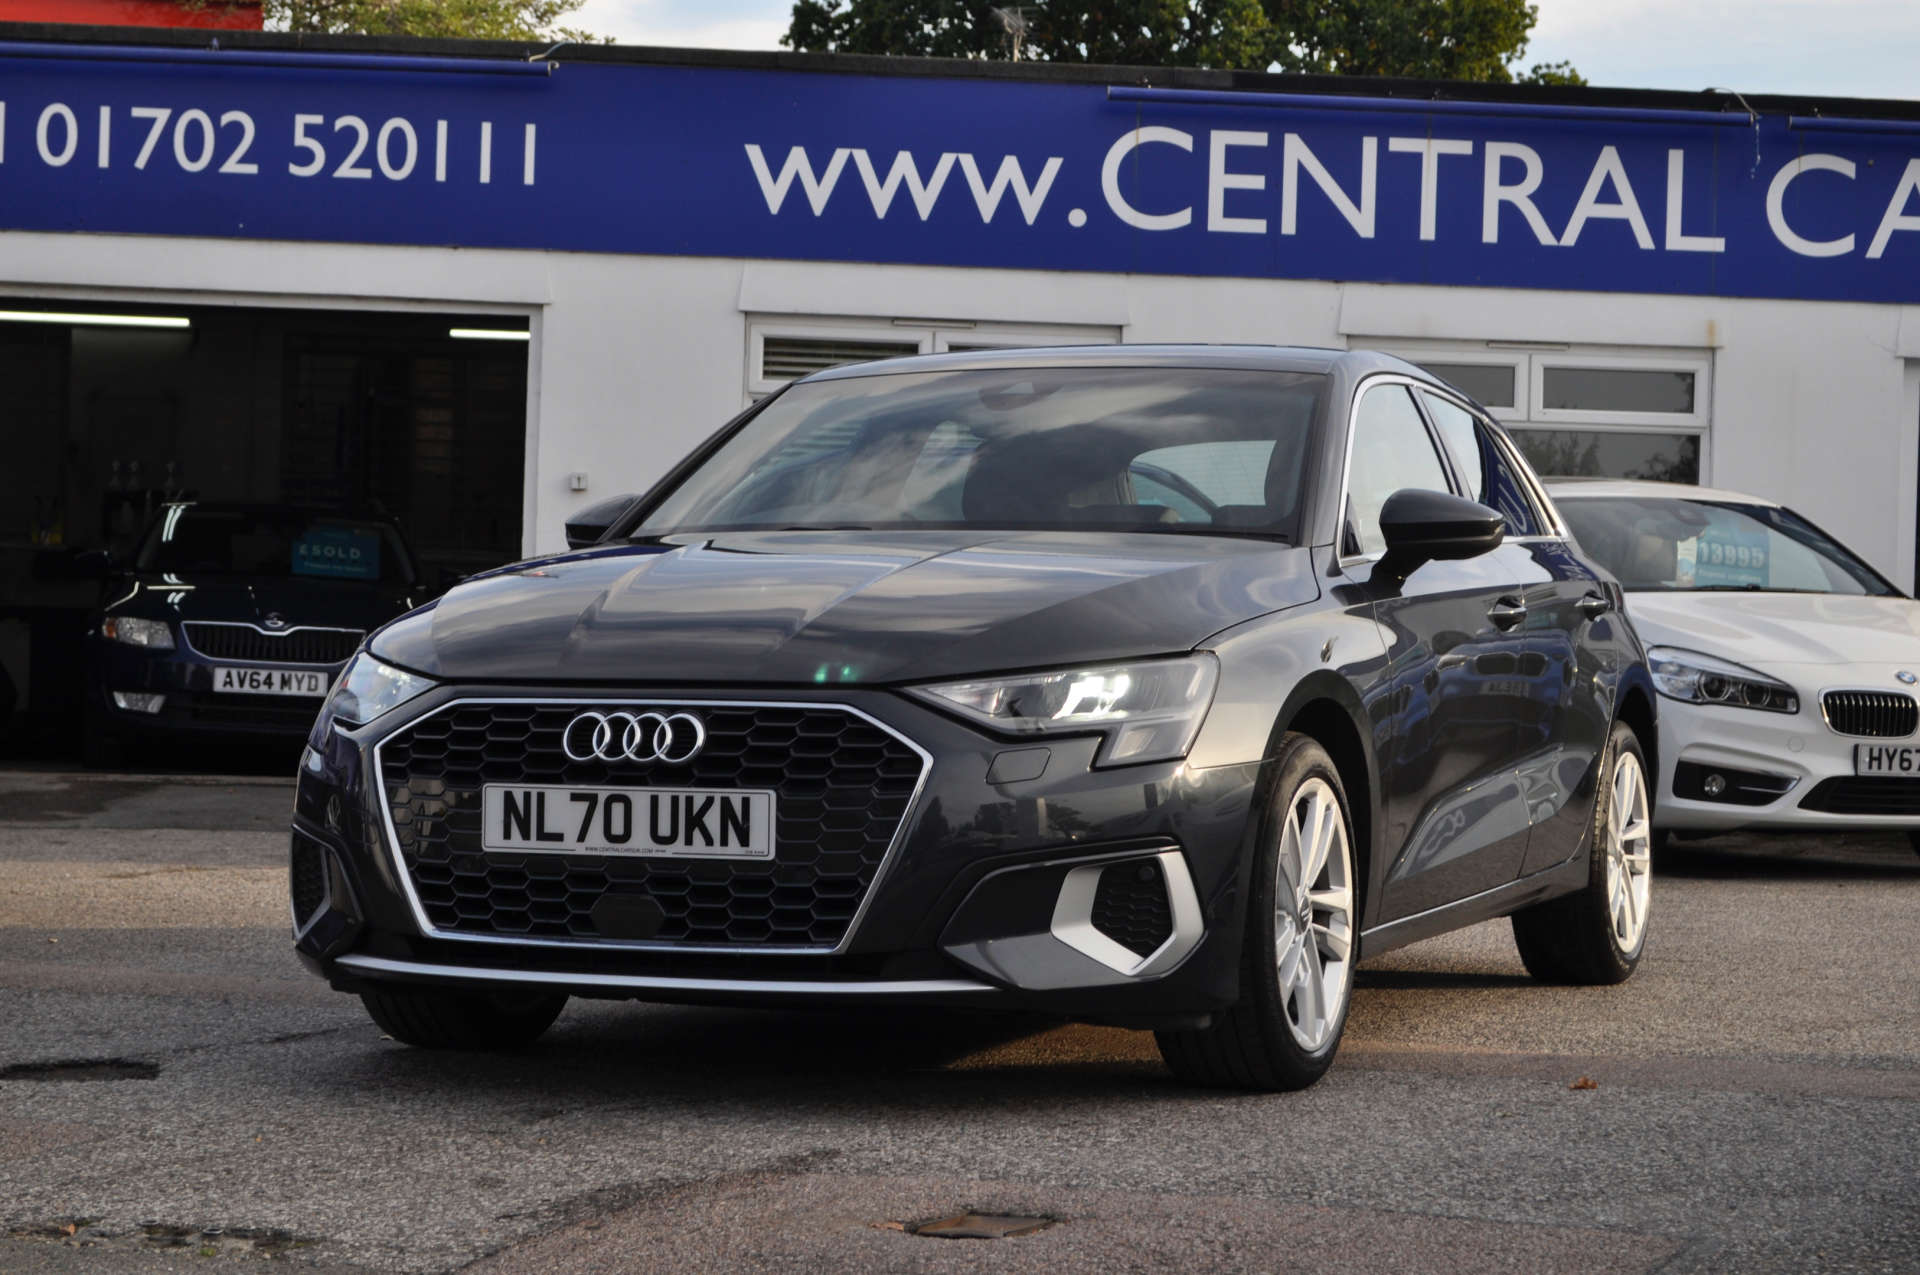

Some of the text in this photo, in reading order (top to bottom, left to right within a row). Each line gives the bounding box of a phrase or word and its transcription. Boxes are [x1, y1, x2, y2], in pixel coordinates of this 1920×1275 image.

[36, 102, 259, 175] 01702
[288, 114, 536, 186] 520111
[222, 670, 320, 693] AV64 MYD
[502, 790, 751, 848] NL70 UKN
